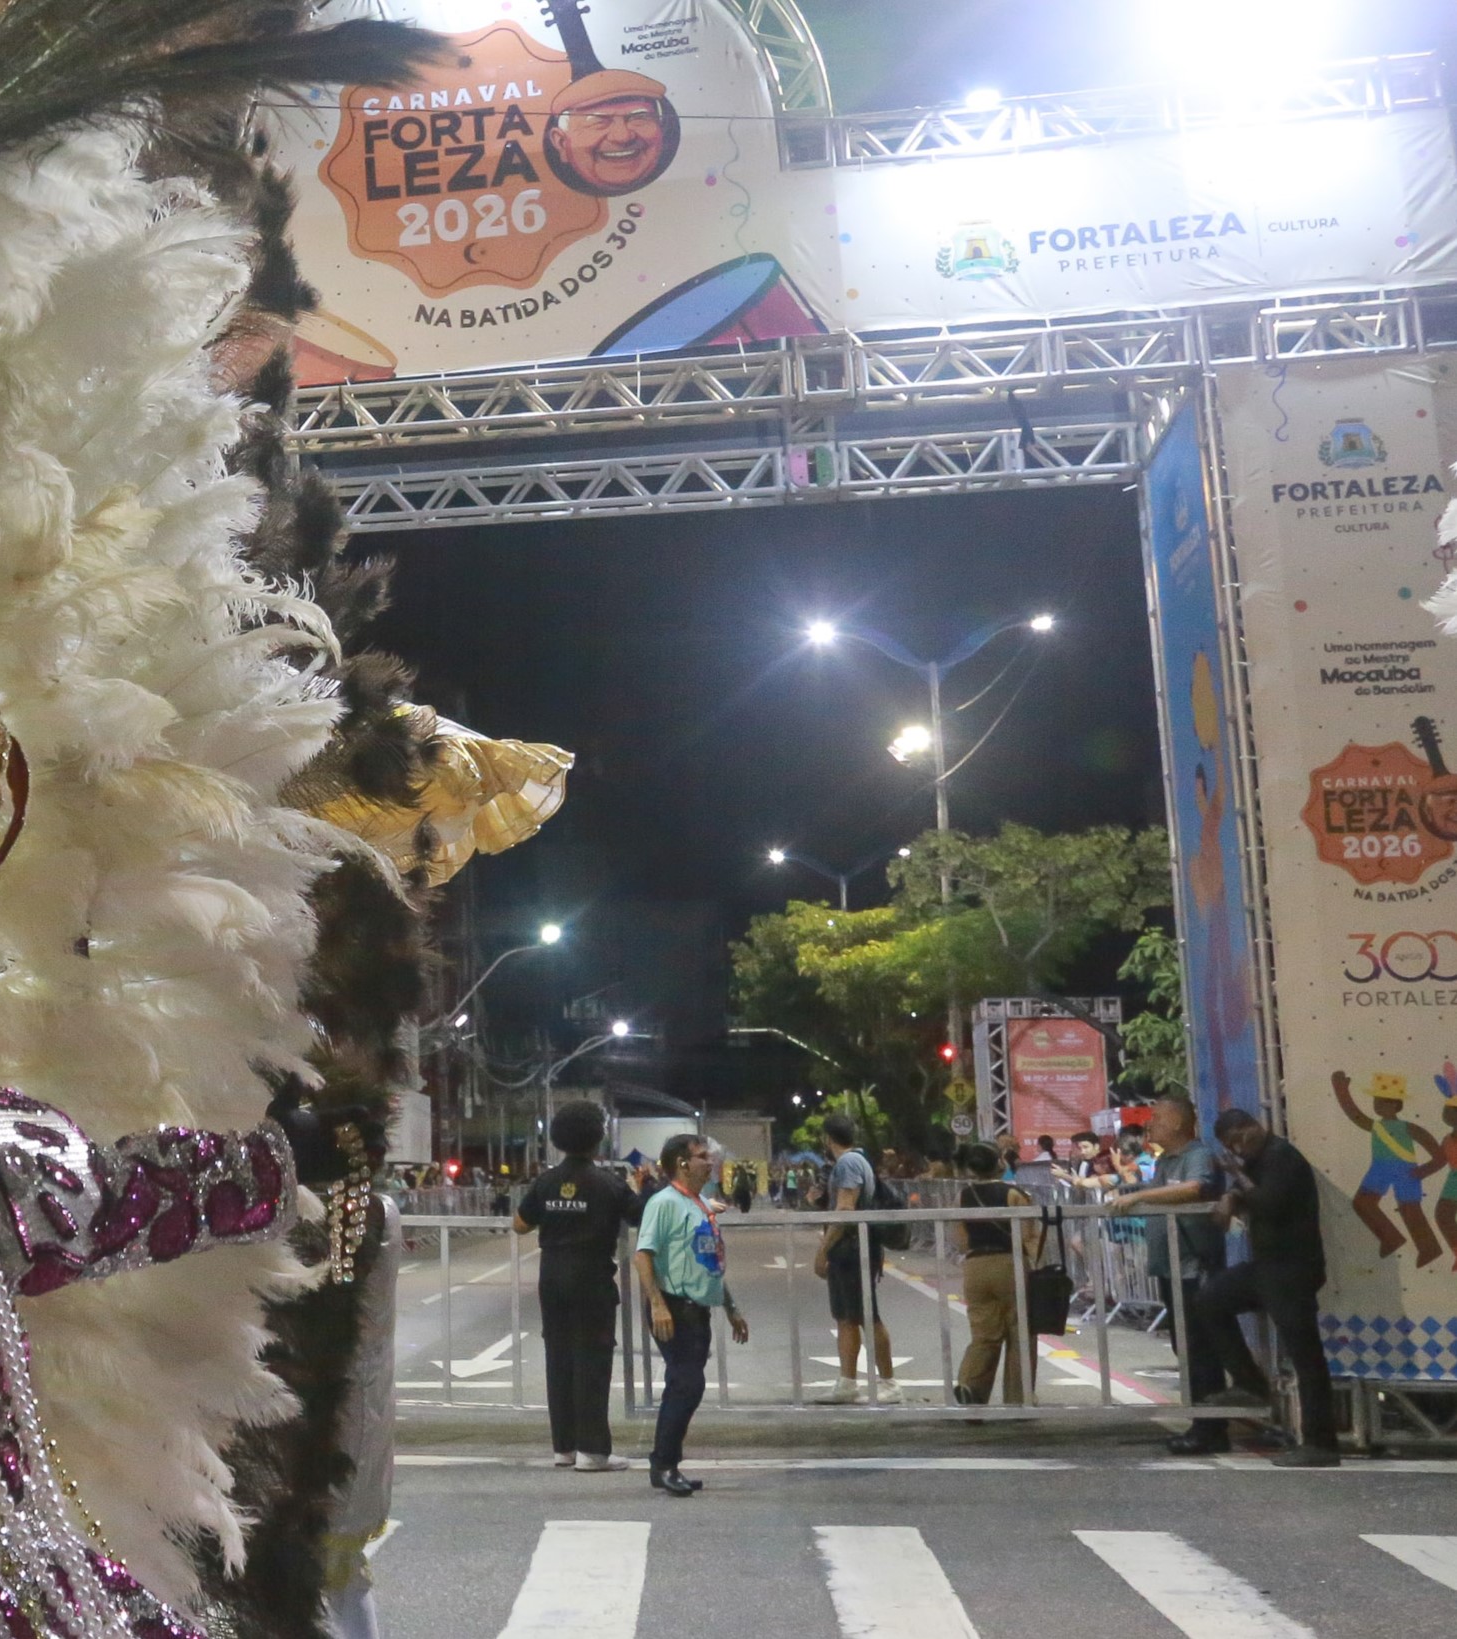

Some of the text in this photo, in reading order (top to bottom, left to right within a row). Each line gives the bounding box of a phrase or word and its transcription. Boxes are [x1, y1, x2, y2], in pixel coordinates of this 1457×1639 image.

[363, 80, 542, 116] CARNAVAL
[363, 104, 534, 154] FORTA
[365, 139, 540, 201] LEZA
[396, 188, 546, 247] 2026
[1028, 212, 1340, 255] FORTALEZA CULTURA
[414, 202, 645, 328] NA BATIDA DOS 300
[1058, 245, 1220, 273] PREFEITURA
[1272, 474, 1445, 503] FORTALEZA
[1297, 500, 1424, 519] PREFEITURA
[1335, 522, 1389, 533] CULTURA
[1324, 640, 1437, 653] Uma homenagem
[1344, 656, 1361, 665] ao
[1354, 684, 1436, 695] do Bandolim
[1322, 775, 1417, 788] CARNAVAL
[1325, 807, 1418, 833] LEZA
[1342, 834, 1422, 859] 2026
[1353, 867, 1456, 902] NA BATIDA DOS
[1343, 989, 1457, 1007] FORTALEZ
